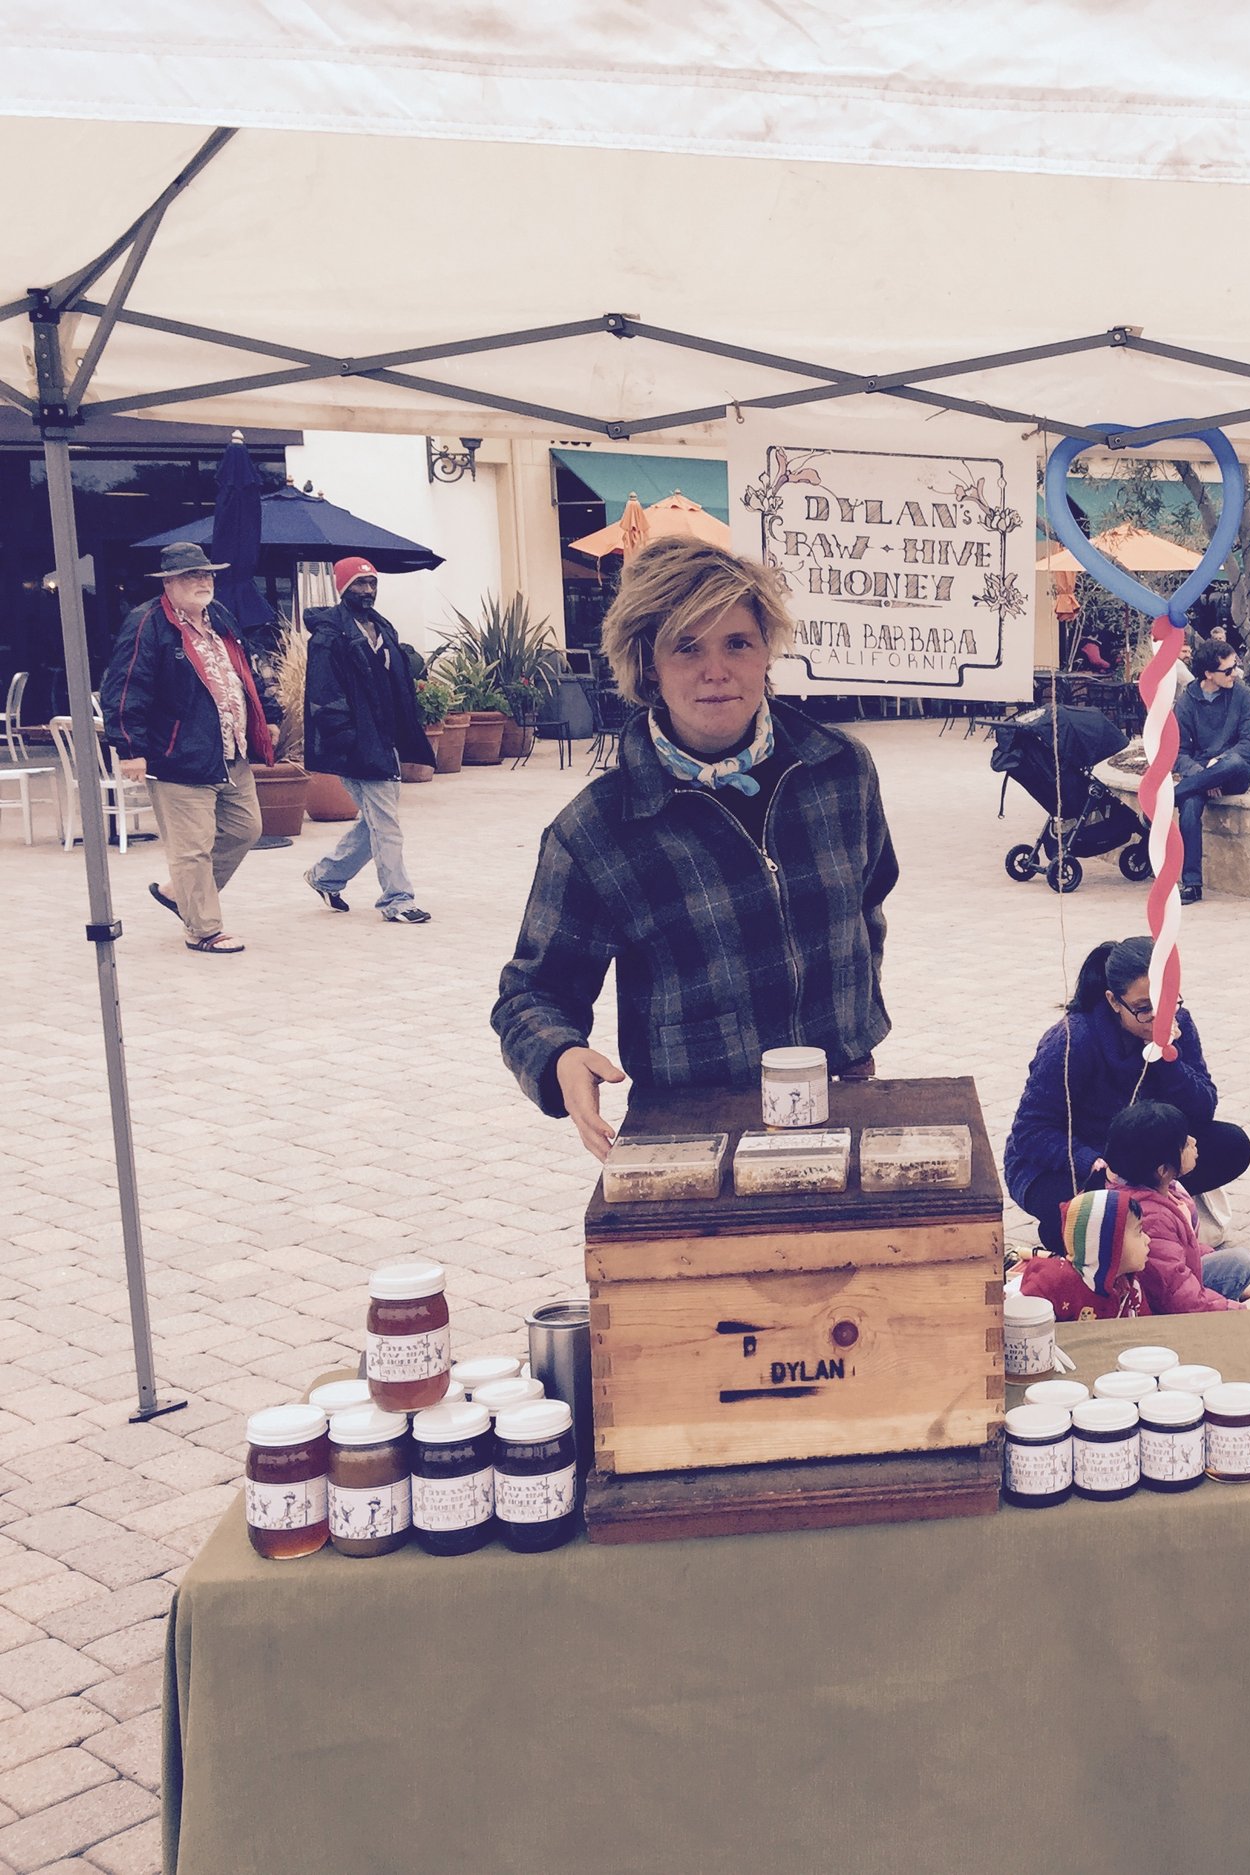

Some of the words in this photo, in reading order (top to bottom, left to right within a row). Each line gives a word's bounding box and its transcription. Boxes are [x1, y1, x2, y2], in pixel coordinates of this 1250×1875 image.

[783, 530, 871, 560] RAW
[903, 538, 992, 568] HIVE
[808, 567, 955, 601] HONEY
[793, 619, 851, 648] ANTA
[863, 623, 978, 655] BARBARA
[809, 649, 959, 670] CALIFORNIA
[771, 1358, 845, 1384] DYLAN
